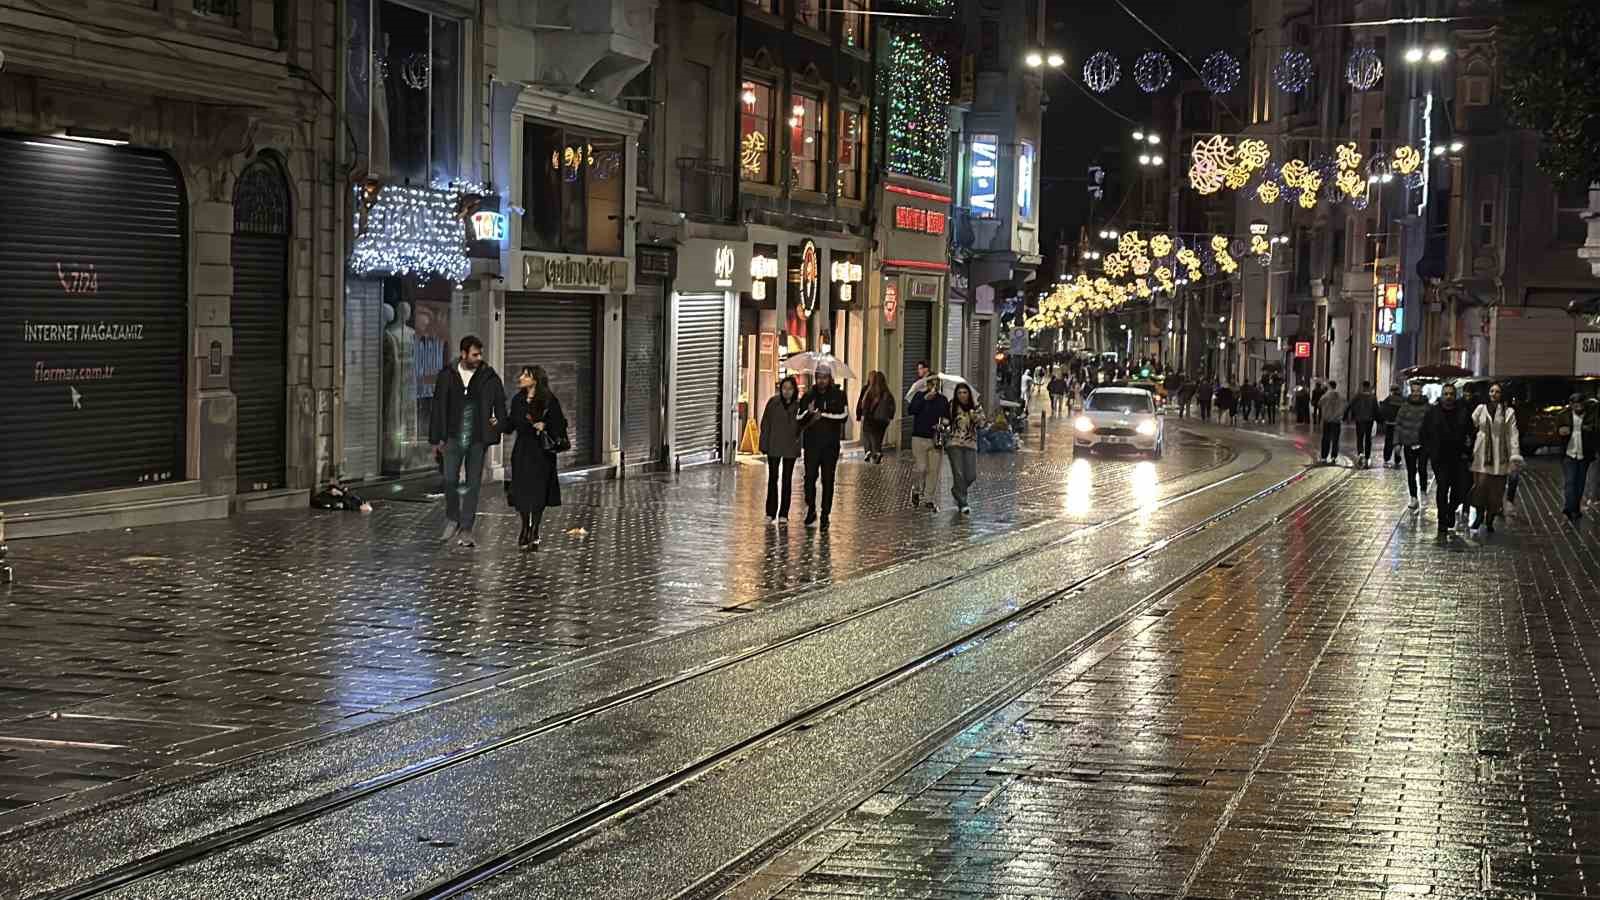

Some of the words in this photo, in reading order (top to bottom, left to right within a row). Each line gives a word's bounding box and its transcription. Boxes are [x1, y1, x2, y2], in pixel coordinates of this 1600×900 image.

[24, 321, 78, 342] İNTERNET
[80, 321, 144, 342] MAĞAZAMIZ
[34, 360, 115, 382] flormar.com.tr
